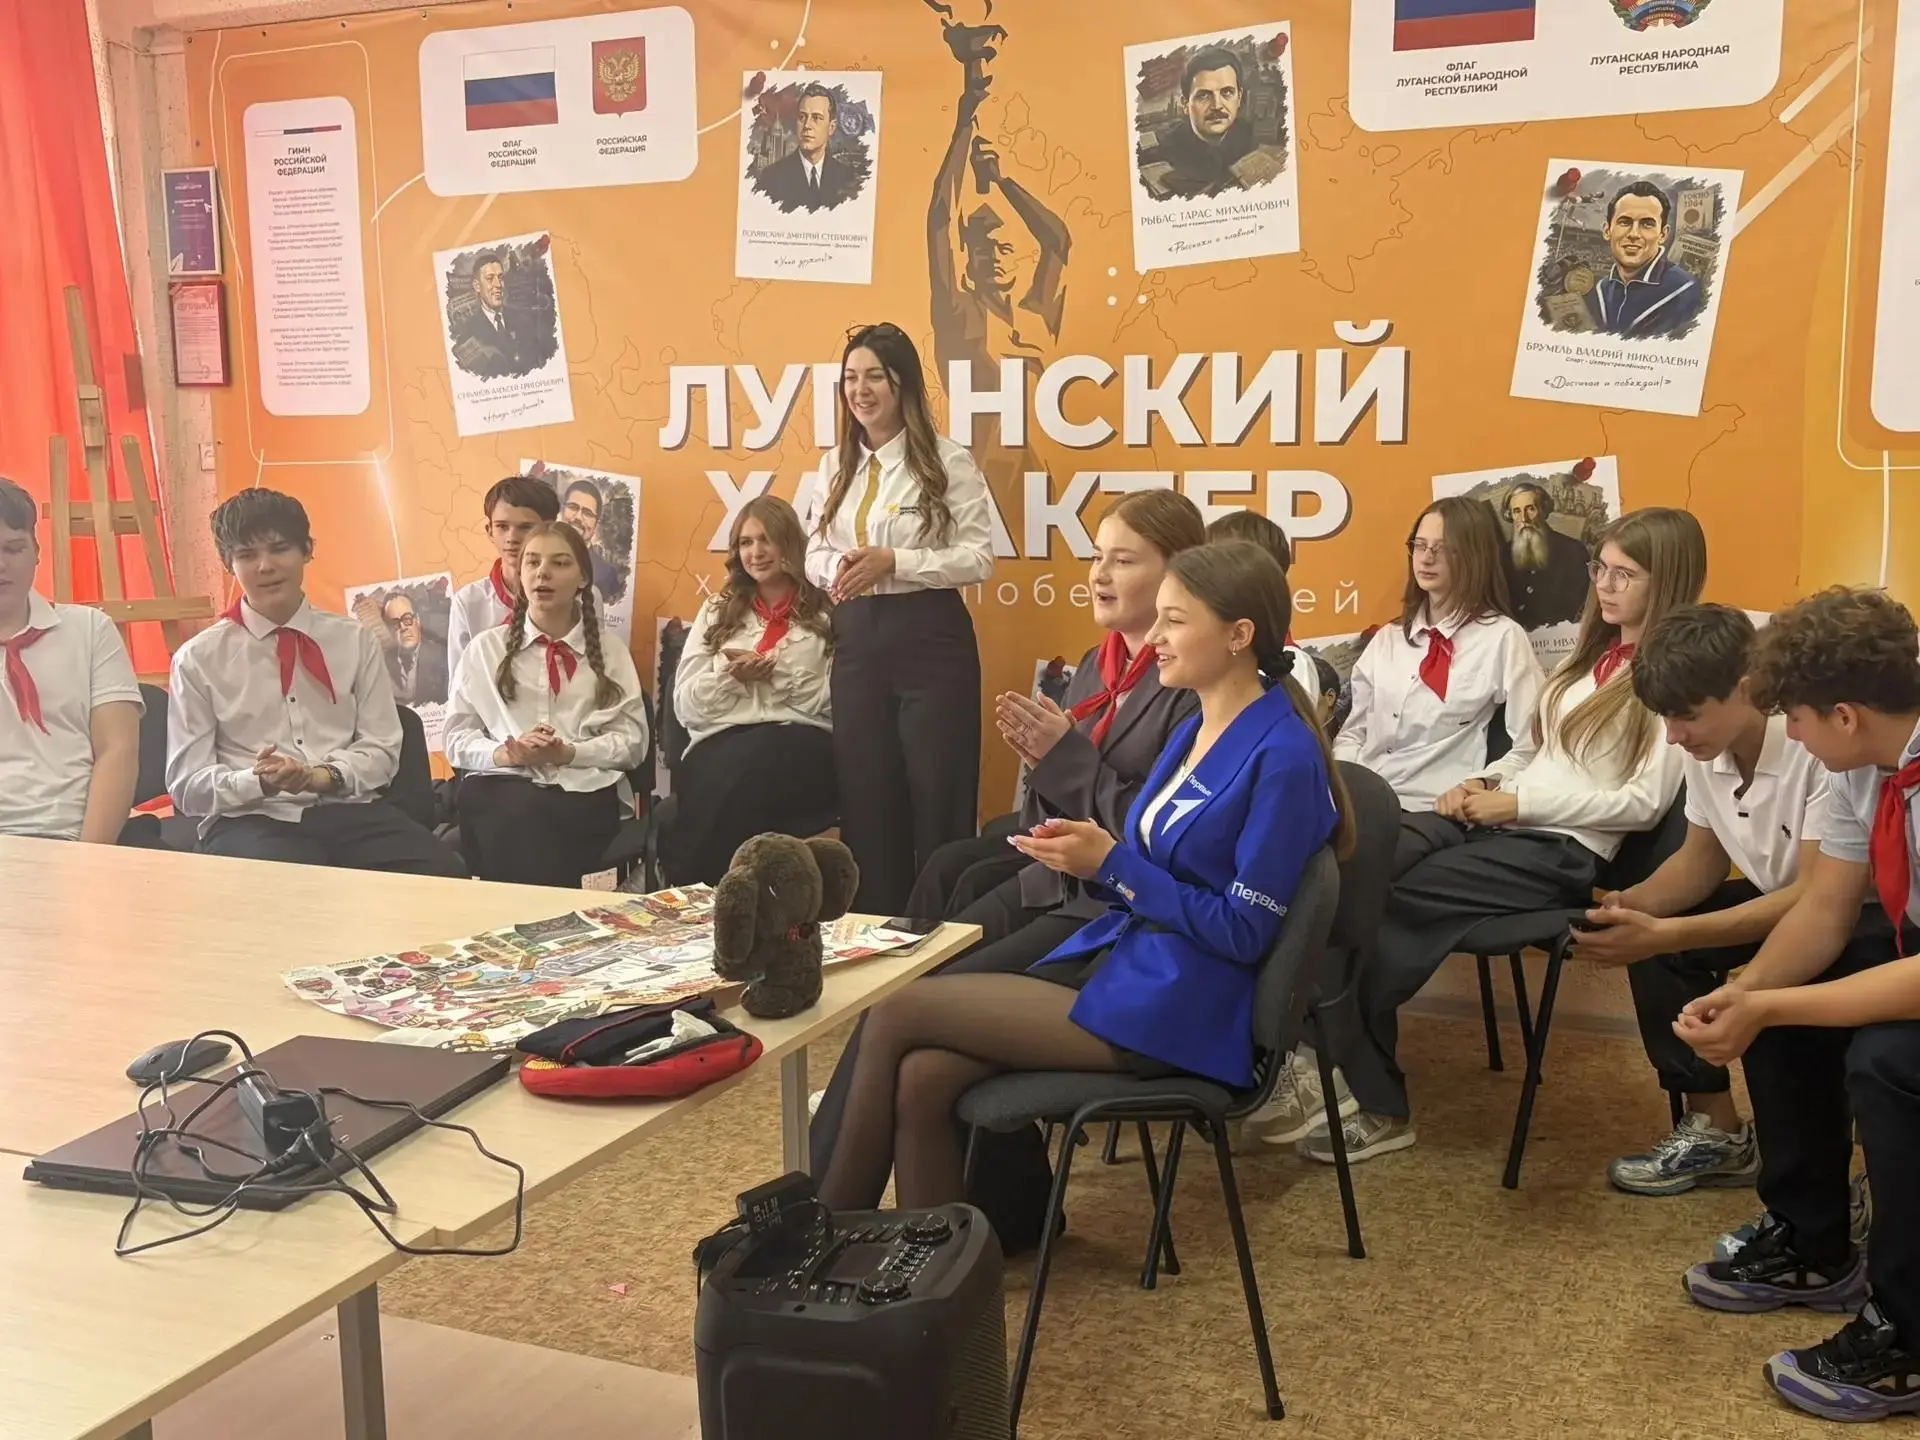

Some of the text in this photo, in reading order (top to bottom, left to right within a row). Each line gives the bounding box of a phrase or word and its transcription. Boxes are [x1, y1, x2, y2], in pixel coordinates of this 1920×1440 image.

[1590, 44, 1730, 65] ЛУГАНСКАЯ НАРОДНАЯ
[1446, 61, 1478, 71] ФЛАГ
[1619, 60, 1699, 75] РЕСПУБЛИКА
[1396, 67, 1528, 88] ЛУГАНСКОЙ НАРОДНОЙ
[1424, 83, 1498, 96] РЕСПУБЛИКИ
[502, 139, 522, 148] ФЛАГ
[596, 134, 647, 145] РОССИЙСКАЯ
[287, 146, 311, 155] ГИМН
[488, 146, 538, 158] РОССИЙСКОЙ
[599, 145, 646, 155] ФЕДЕРАЦИЯ
[273, 153, 327, 166] РОССИЙСКОЙ
[490, 158, 536, 168] ФЕДЕРАЦИИ
[277, 165, 325, 176] ФЕДЕРАЦИИ
[1140, 212, 1177, 226] РЫБАС
[1180, 208, 1213, 221] ТАРАС
[1526, 341, 1699, 367] БРУМЕЛЬ ВАЛЕРИЙ НИКОЛАЕВИЧ
[659, 319, 1410, 450] ЛУГНСКИЙ
[1186, 774, 1212, 797] Первые
[1231, 881, 1288, 917] Первые
